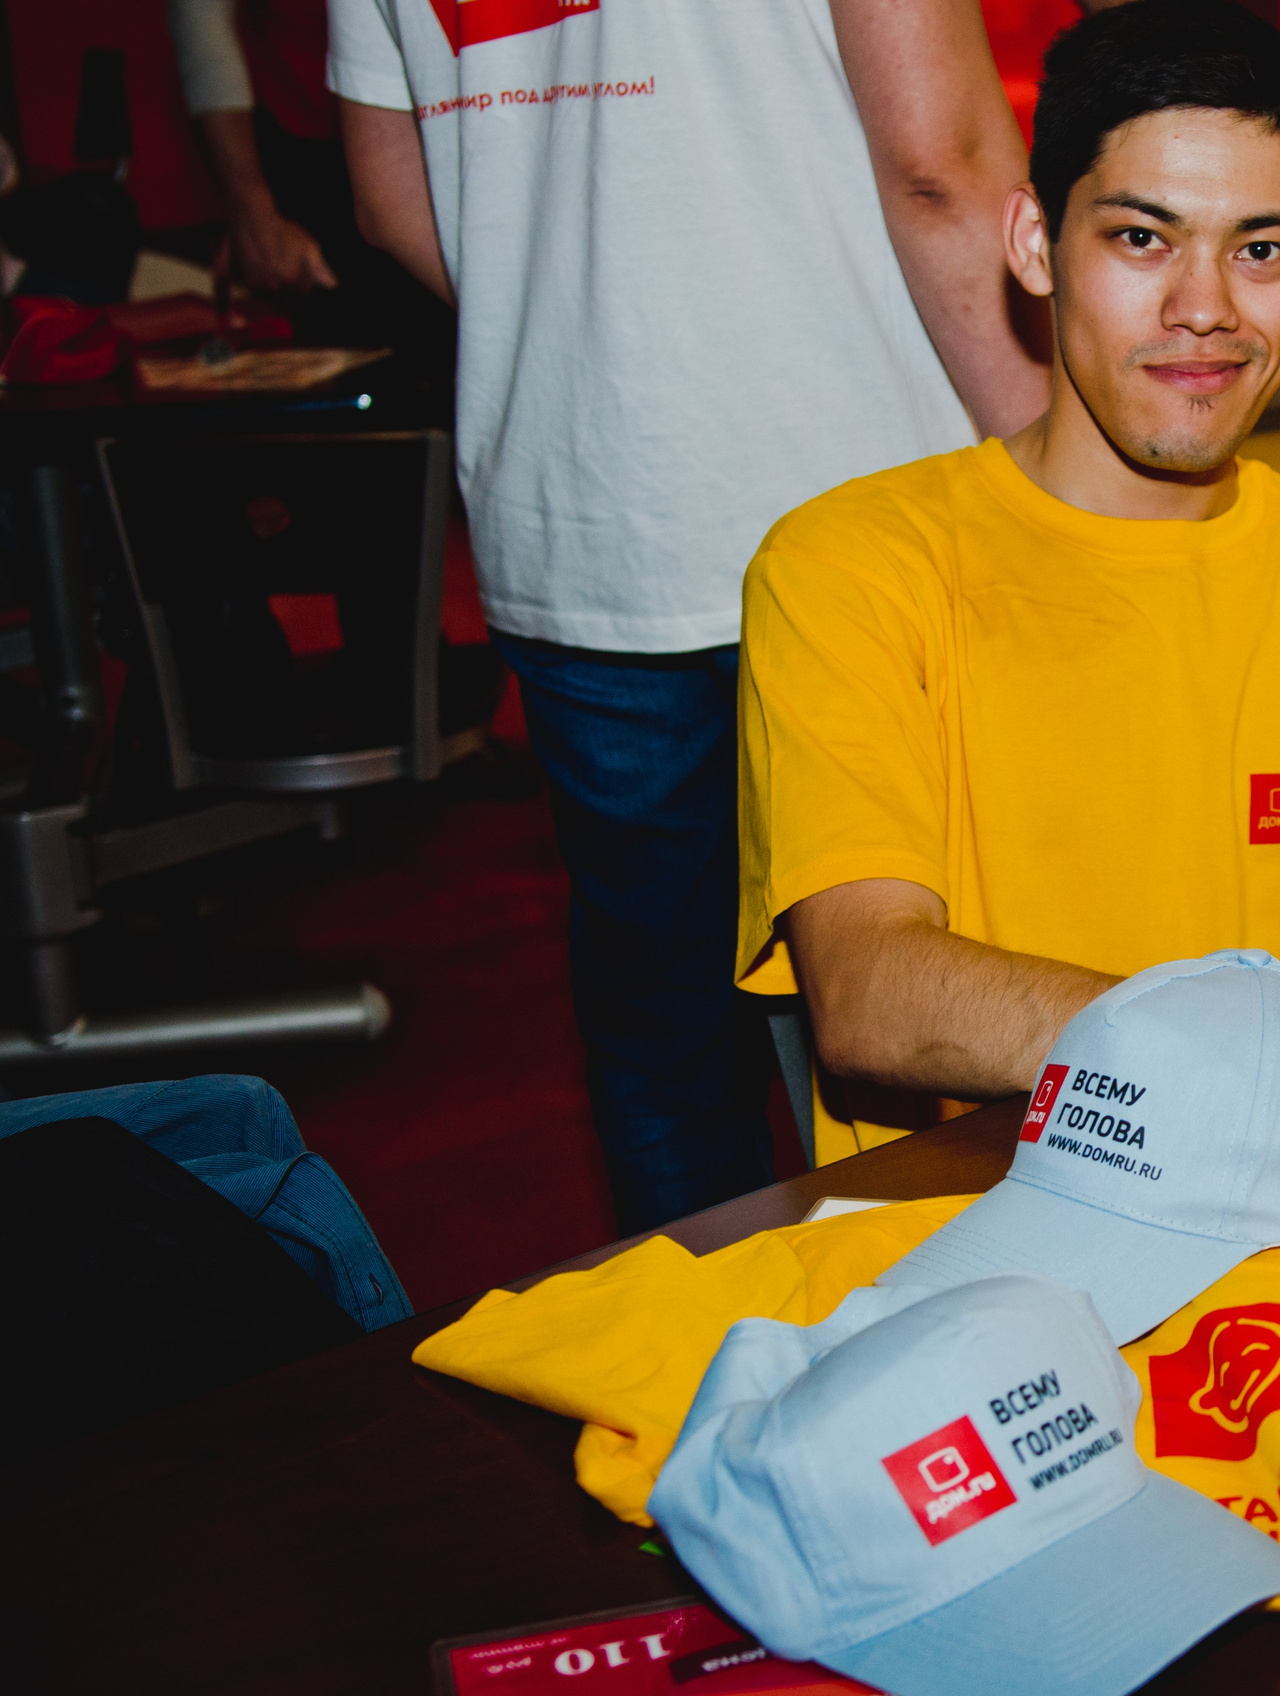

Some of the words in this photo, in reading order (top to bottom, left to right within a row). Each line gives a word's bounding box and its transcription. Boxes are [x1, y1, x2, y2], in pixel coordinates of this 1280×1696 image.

[500, 89, 540, 105] под
[1072, 1069, 1146, 1106] ВСЕМУ
[1057, 1102, 1146, 1150] ГОЛОВА
[1047, 1133, 1163, 1181] WWW.DOMRU.RU
[988, 1369, 1062, 1426] ВСЕМУ
[1011, 1402, 1099, 1466] ГОЛОВА
[1028, 1427, 1124, 1492] WWW.DOMRU.RU
[554, 1633, 672, 1676] 110
